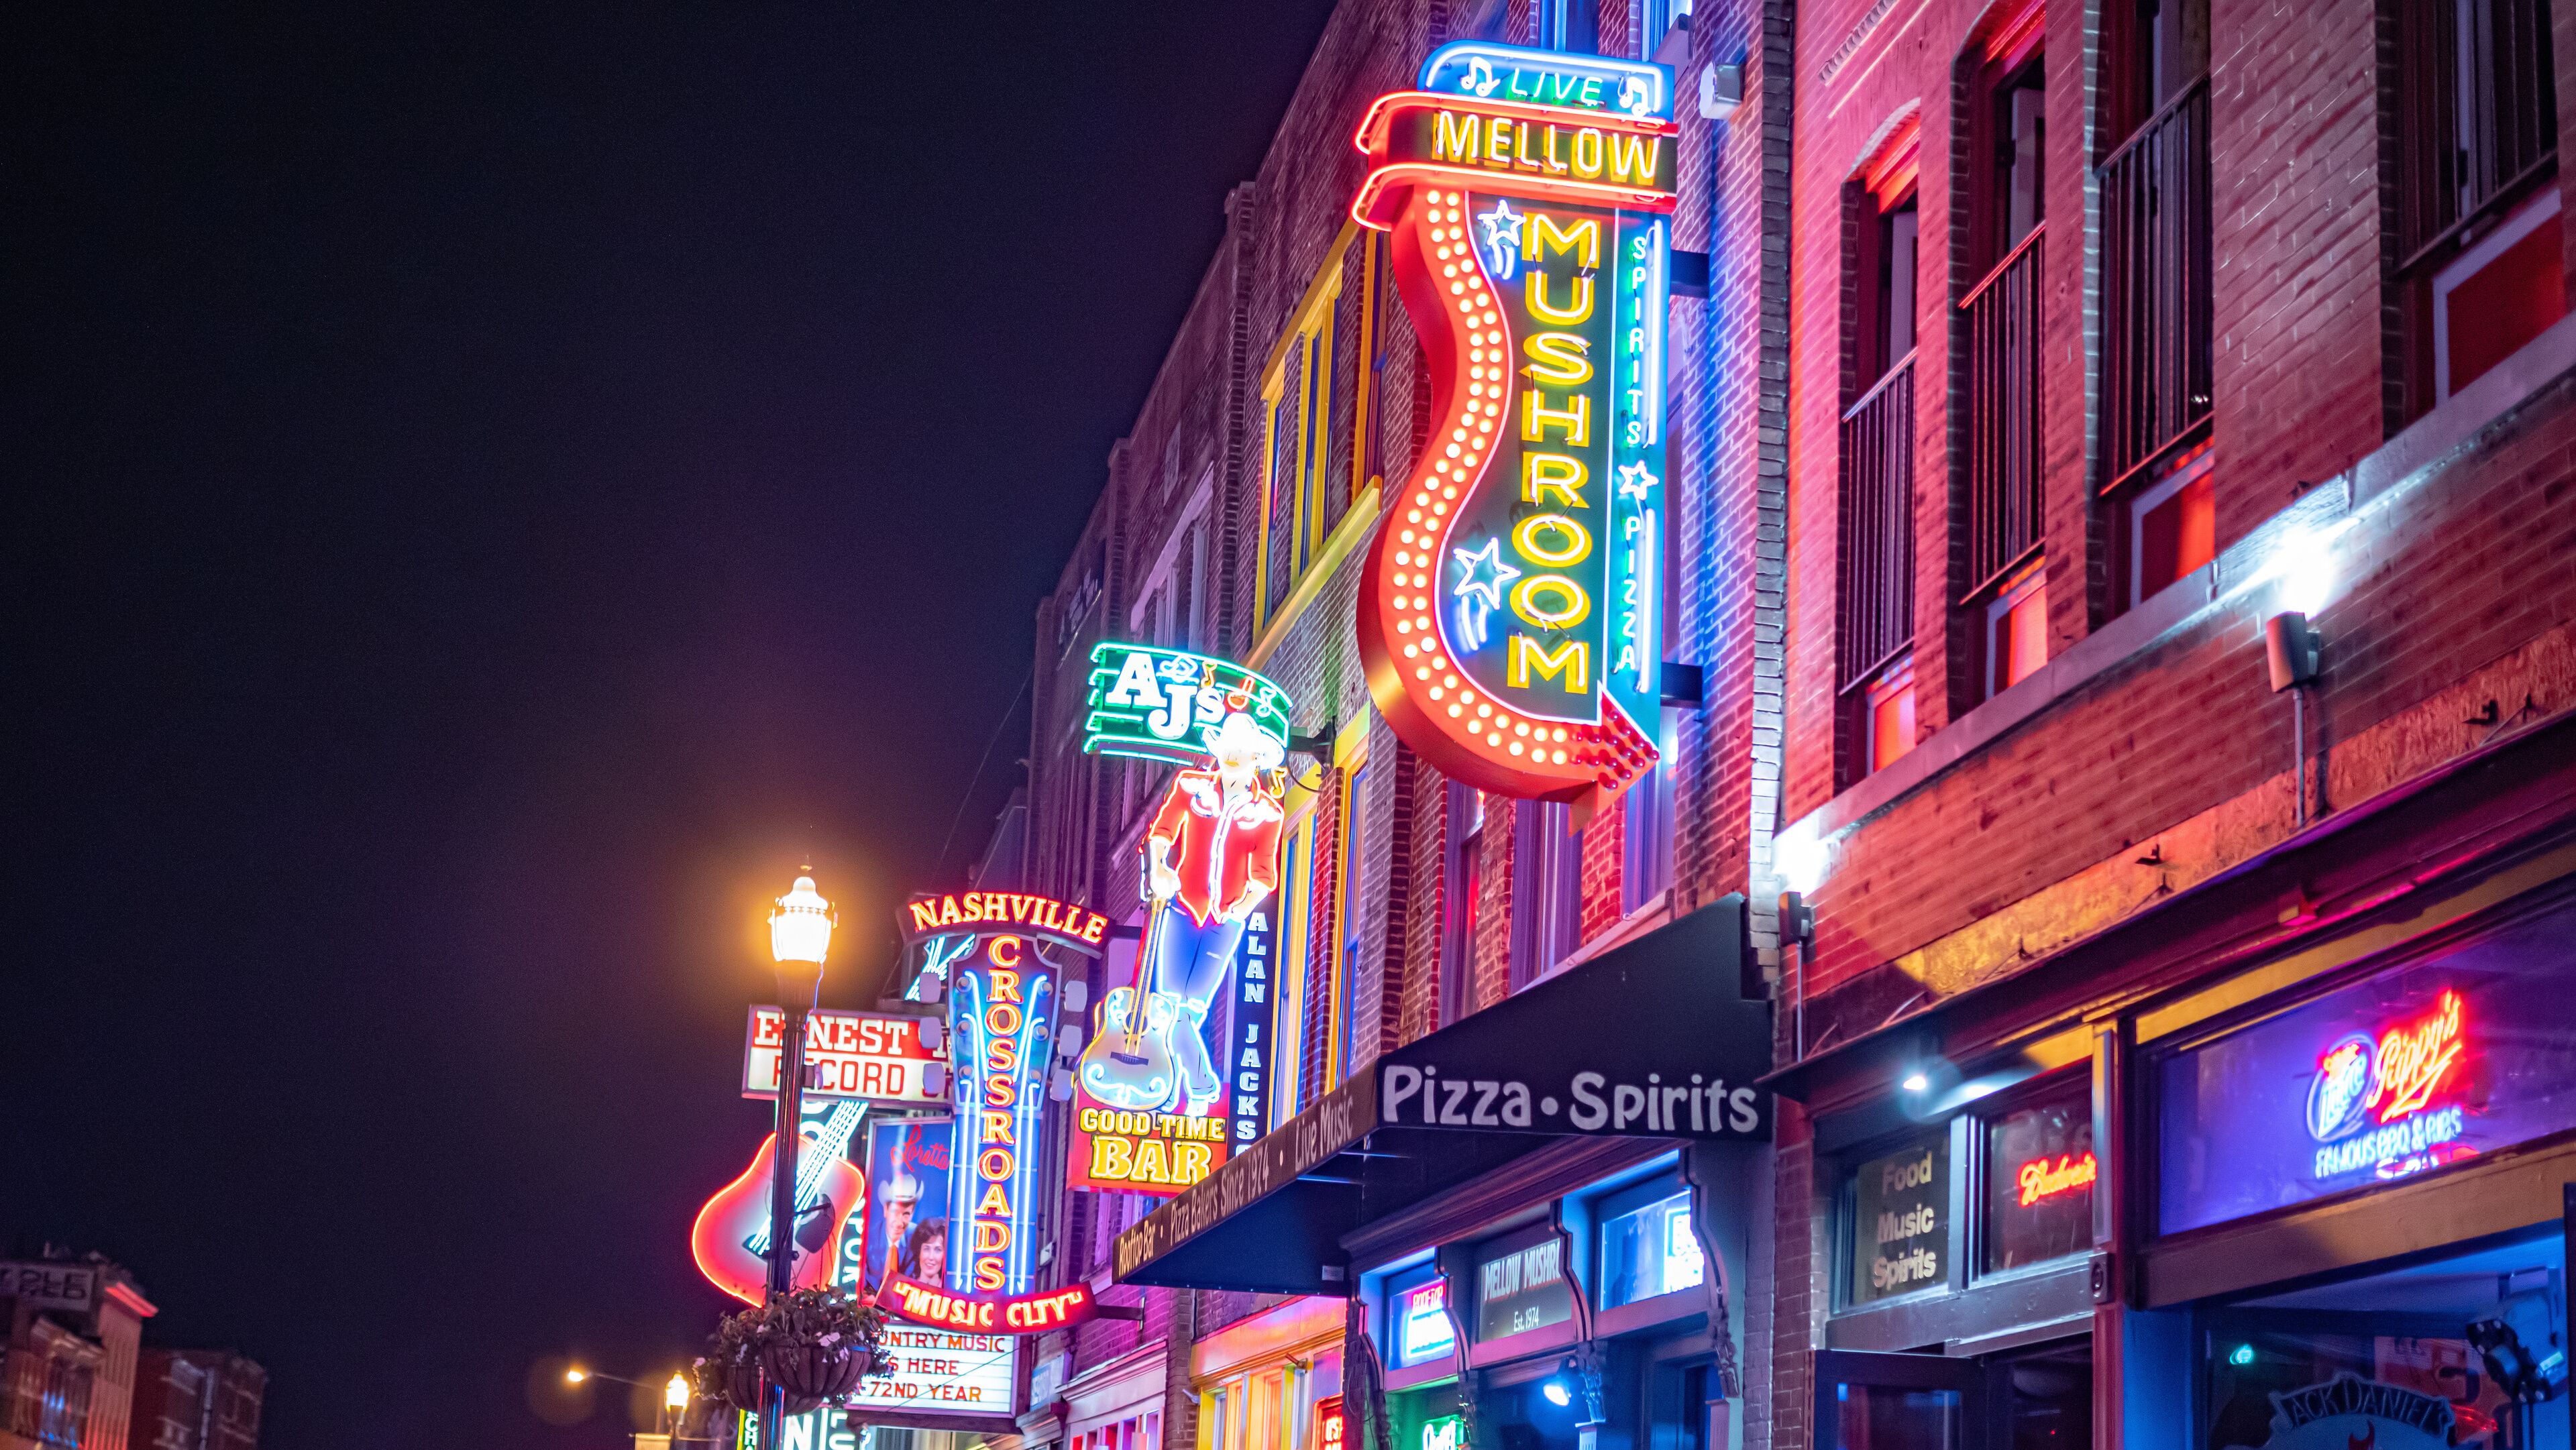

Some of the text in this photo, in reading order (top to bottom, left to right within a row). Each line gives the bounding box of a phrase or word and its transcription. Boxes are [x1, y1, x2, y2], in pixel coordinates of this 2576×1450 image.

[1507, 67, 1605, 107] LIVE
[1432, 110, 1662, 186] MELLOW
[1626, 235, 1648, 445] SPIRITS
[1507, 212, 1601, 695] MUSHROOM
[1619, 516, 1642, 671] PIZZA
[908, 891, 1109, 945] NASHVILLE
[1244, 911, 1268, 1003] ALAN
[754, 1011, 909, 1056] ENEST
[2365, 989, 2461, 1110] Rippy's
[772, 1055, 905, 1096] CORD
[1383, 1064, 1759, 1133] Pizza Spirits
[975, 935, 1023, 1292] CROSSROADS
[1079, 1107, 1226, 1141] GOOD TIME
[890, 1124, 950, 1172] Loretta
[1089, 1135, 1212, 1186] BAR
[1118, 1088, 1354, 1278] Rooftop Bar Pizza Bakers Since 1974 Live Music
[1881, 1150, 1933, 1196] Food
[1878, 1203, 1935, 1244] Music
[1485, 1253, 1521, 1302] MELLOW
[1874, 1247, 1937, 1290] Spirits
[877, 1331, 1006, 1353] UNTRY MUSIC
[1513, 1305, 1540, 1333] Est. 1974
[907, 1357, 960, 1376] HERE
[870, 1381, 918, 1399] 72ND
[928, 1383, 982, 1402] YEAR
